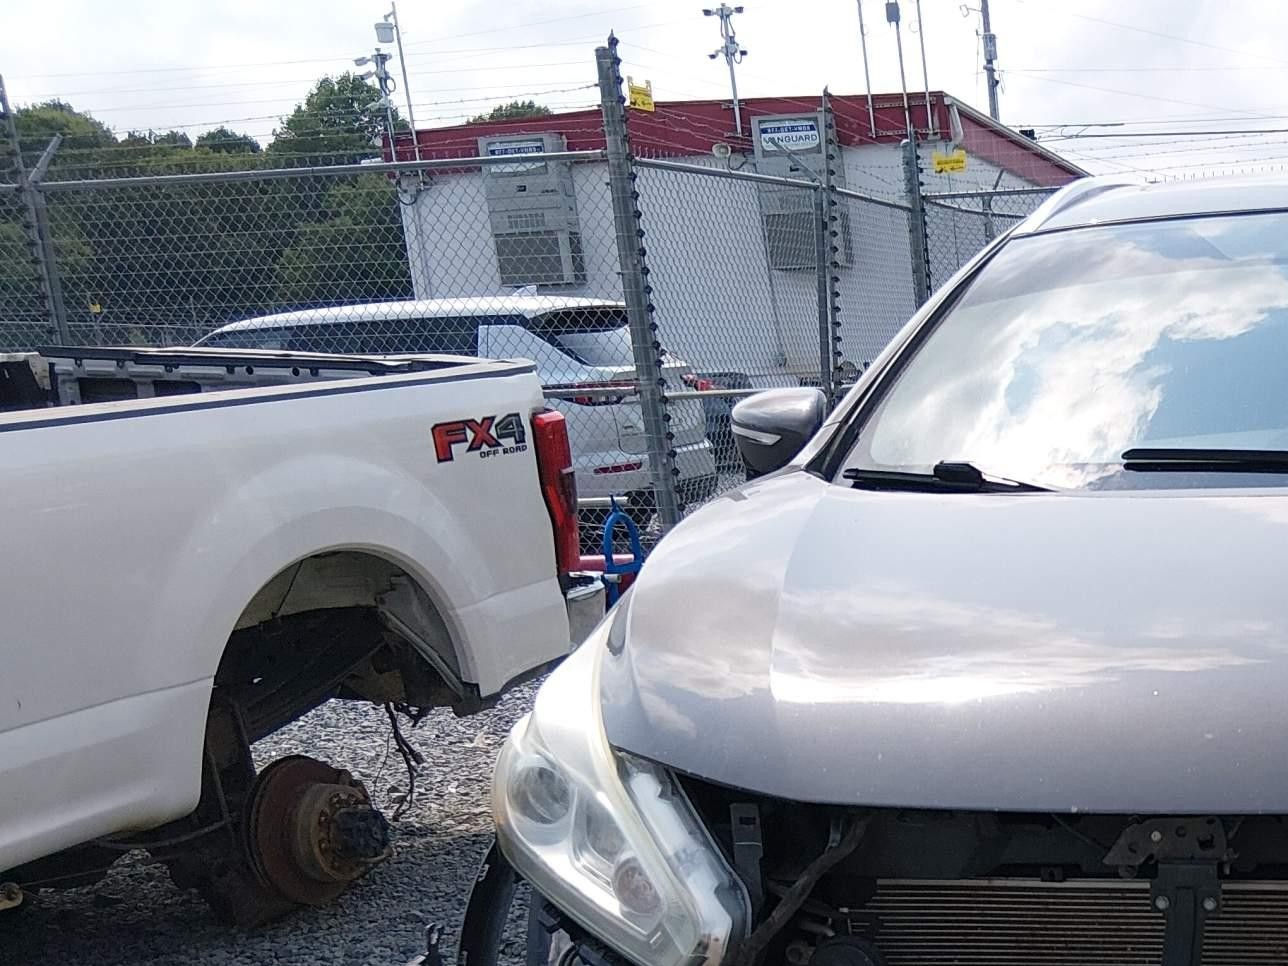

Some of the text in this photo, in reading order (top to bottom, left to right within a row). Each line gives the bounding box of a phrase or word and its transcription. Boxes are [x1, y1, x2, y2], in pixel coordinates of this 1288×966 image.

[431, 412, 526, 464] FX4
[480, 444, 528, 459] OFF ROAD
